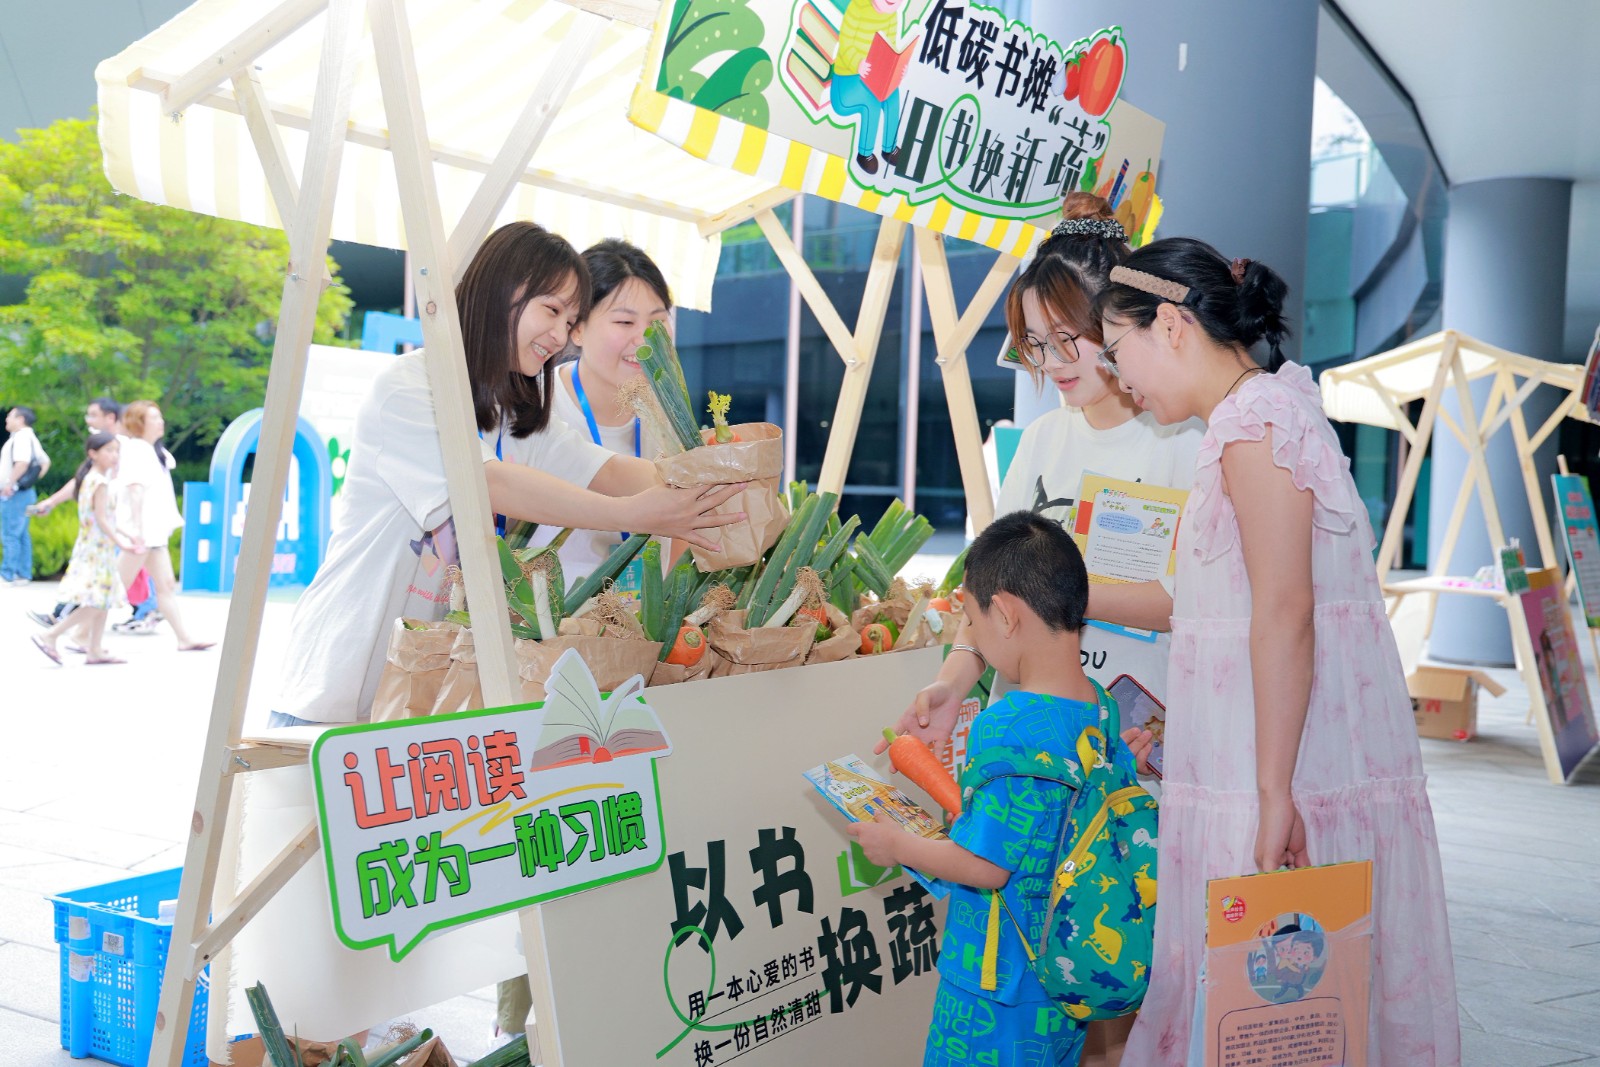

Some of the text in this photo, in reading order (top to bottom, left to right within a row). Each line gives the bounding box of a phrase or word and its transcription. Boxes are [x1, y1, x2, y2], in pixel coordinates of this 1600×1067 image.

[918, 0, 1058, 115] 低碳书摊
[343, 730, 527, 830] 让阅读
[355, 791, 648, 919] 成为一种习惯
[667, 826, 814, 953] 以书
[689, 946, 816, 1020] 用一本心爱的书
[817, 881, 941, 1014] 换蔬
[694, 990, 821, 1067] 换一份自然清甜
